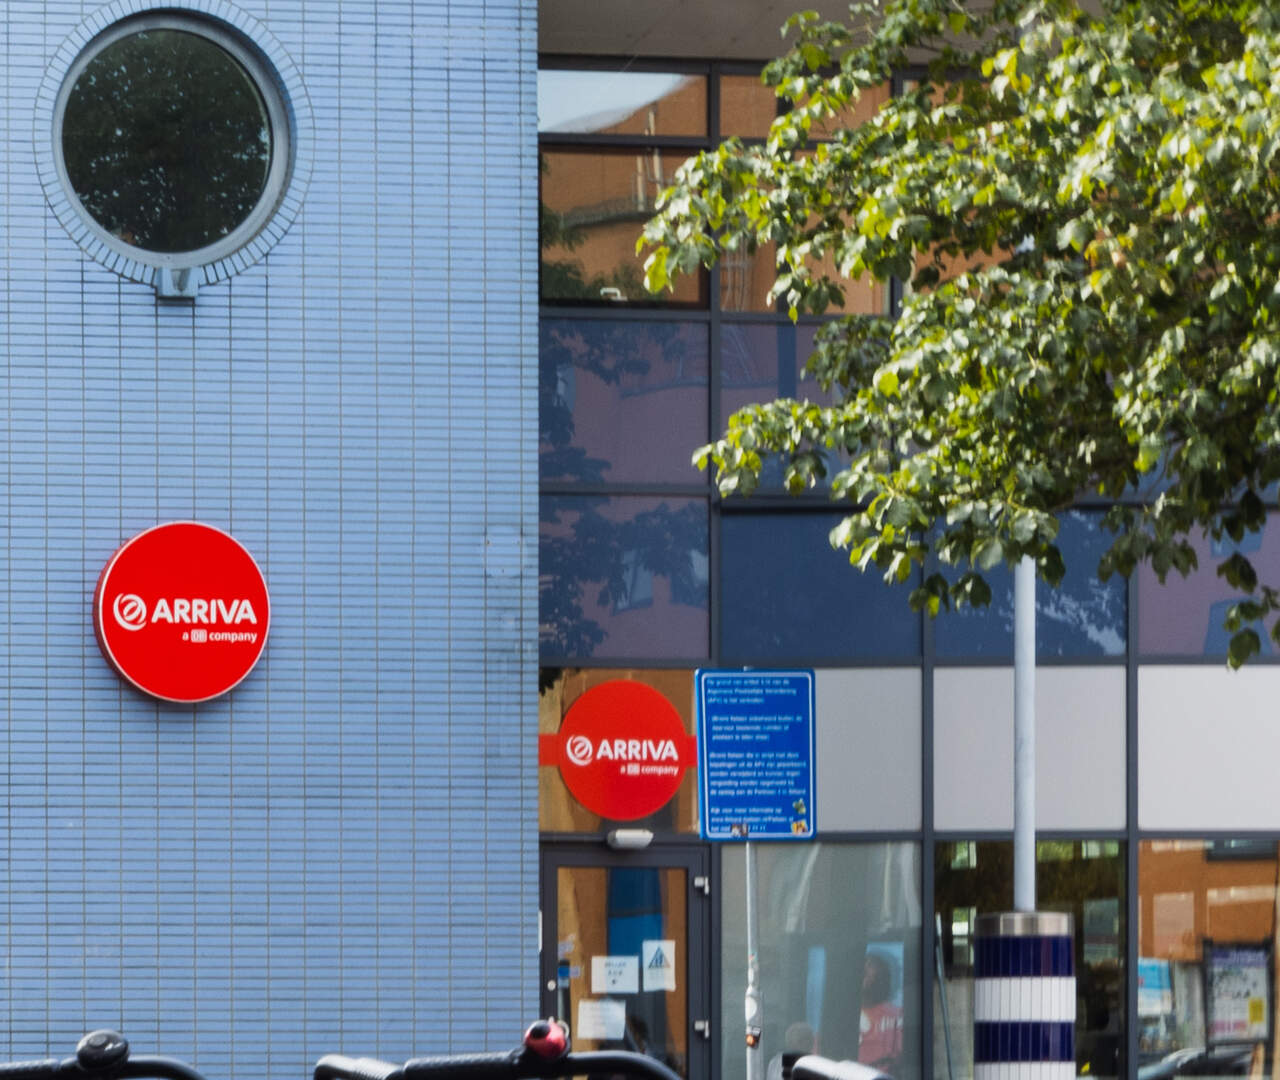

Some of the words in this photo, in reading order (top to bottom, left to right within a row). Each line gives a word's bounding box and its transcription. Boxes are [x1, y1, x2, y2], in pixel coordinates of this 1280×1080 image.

[151, 598, 257, 624] ARRIVA
[209, 631, 257, 644] company
[596, 738, 679, 761] ARRIVA
[641, 766, 679, 776] company
